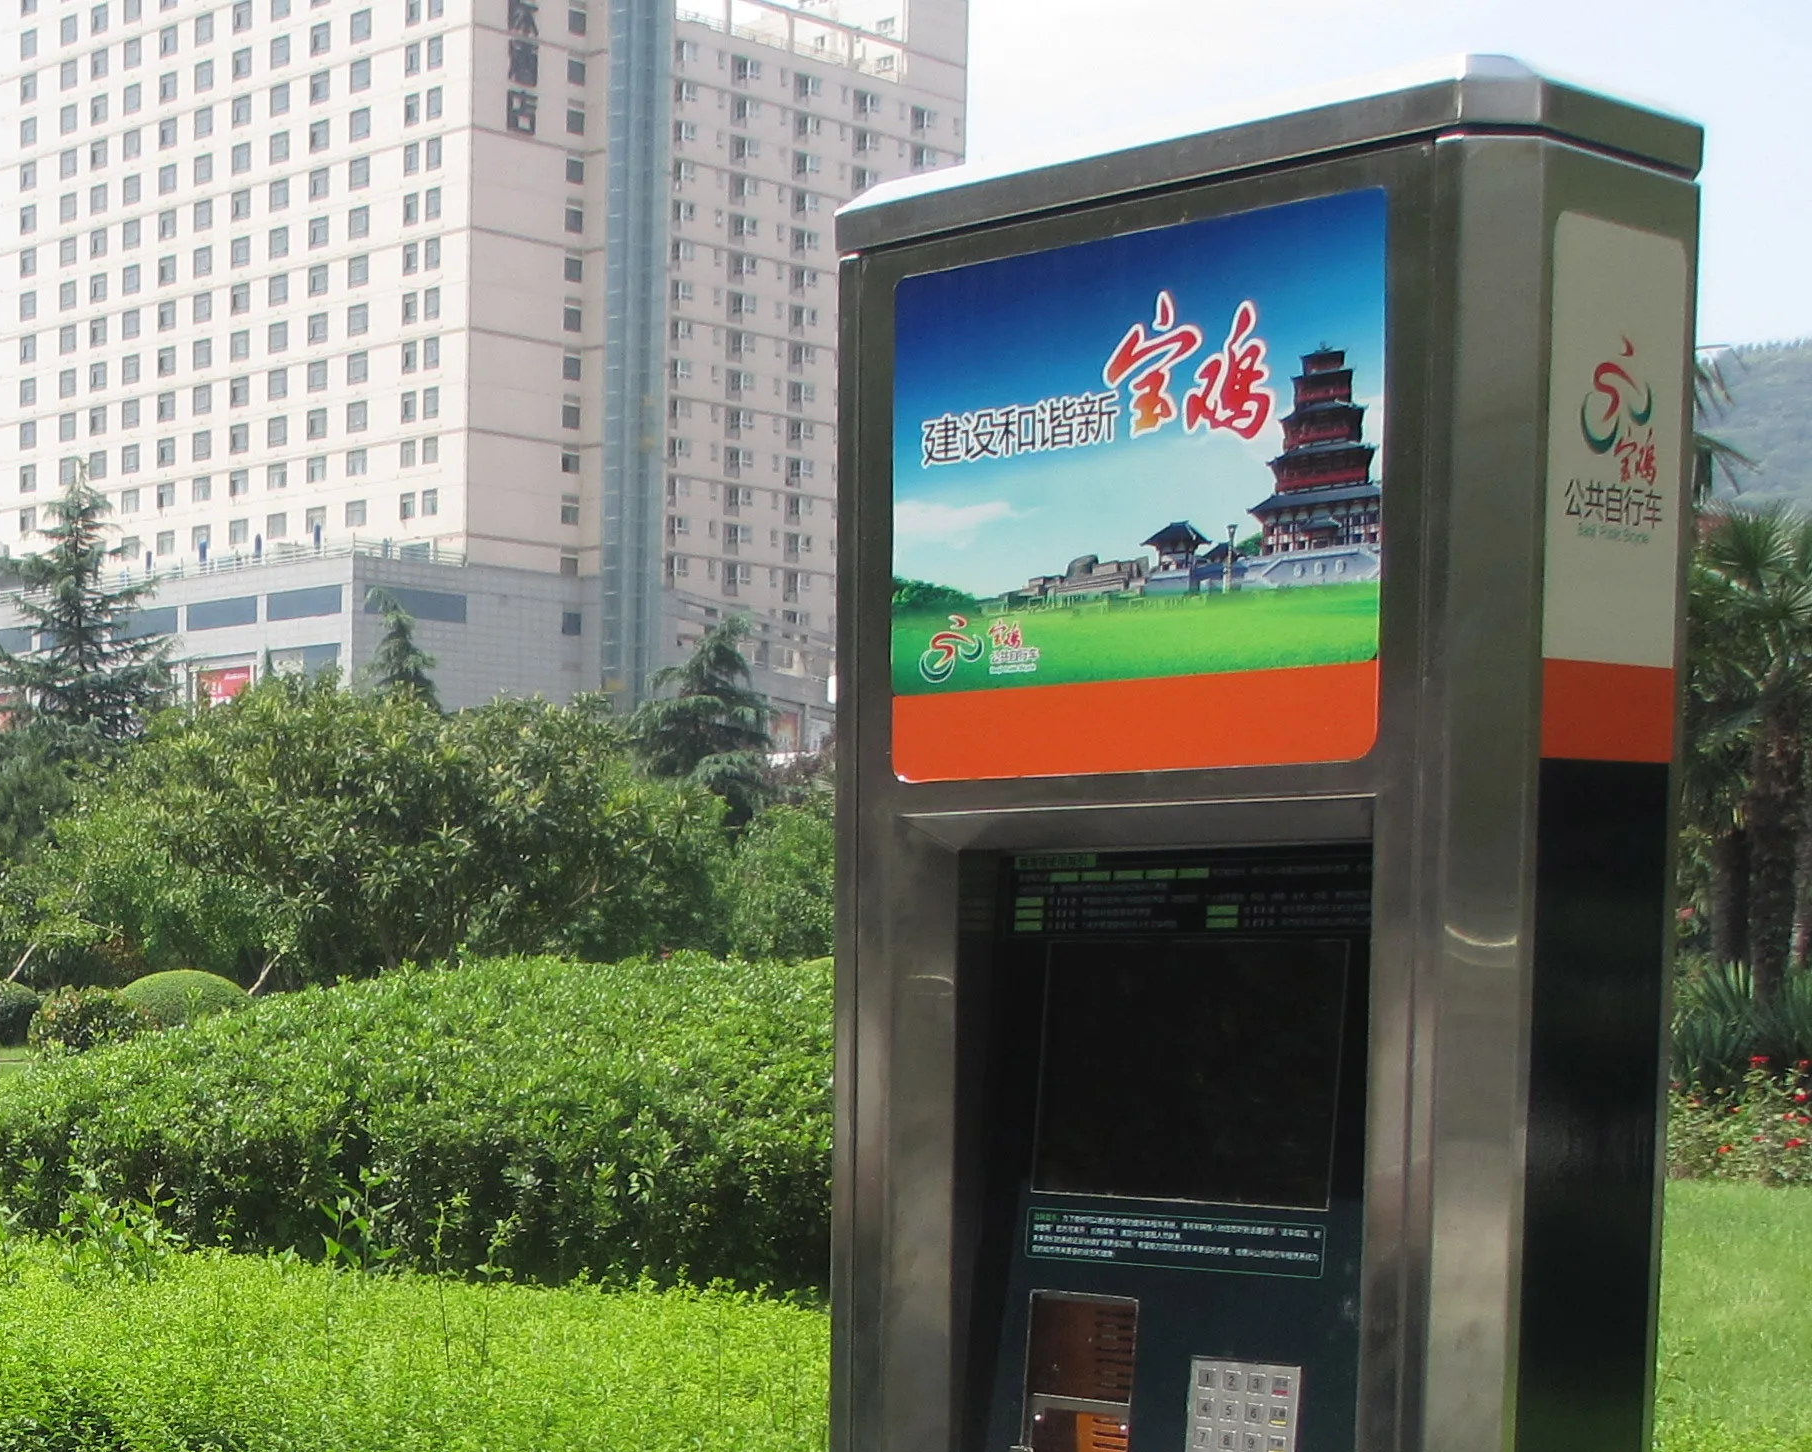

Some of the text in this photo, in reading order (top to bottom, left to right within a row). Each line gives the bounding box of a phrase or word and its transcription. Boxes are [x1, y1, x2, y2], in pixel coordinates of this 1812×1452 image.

[923, 290, 1276, 467] 建设和谐新 宝鸡
[1613, 427, 1656, 486] 宝鸡
[1564, 479, 1663, 529] 公共自行车
